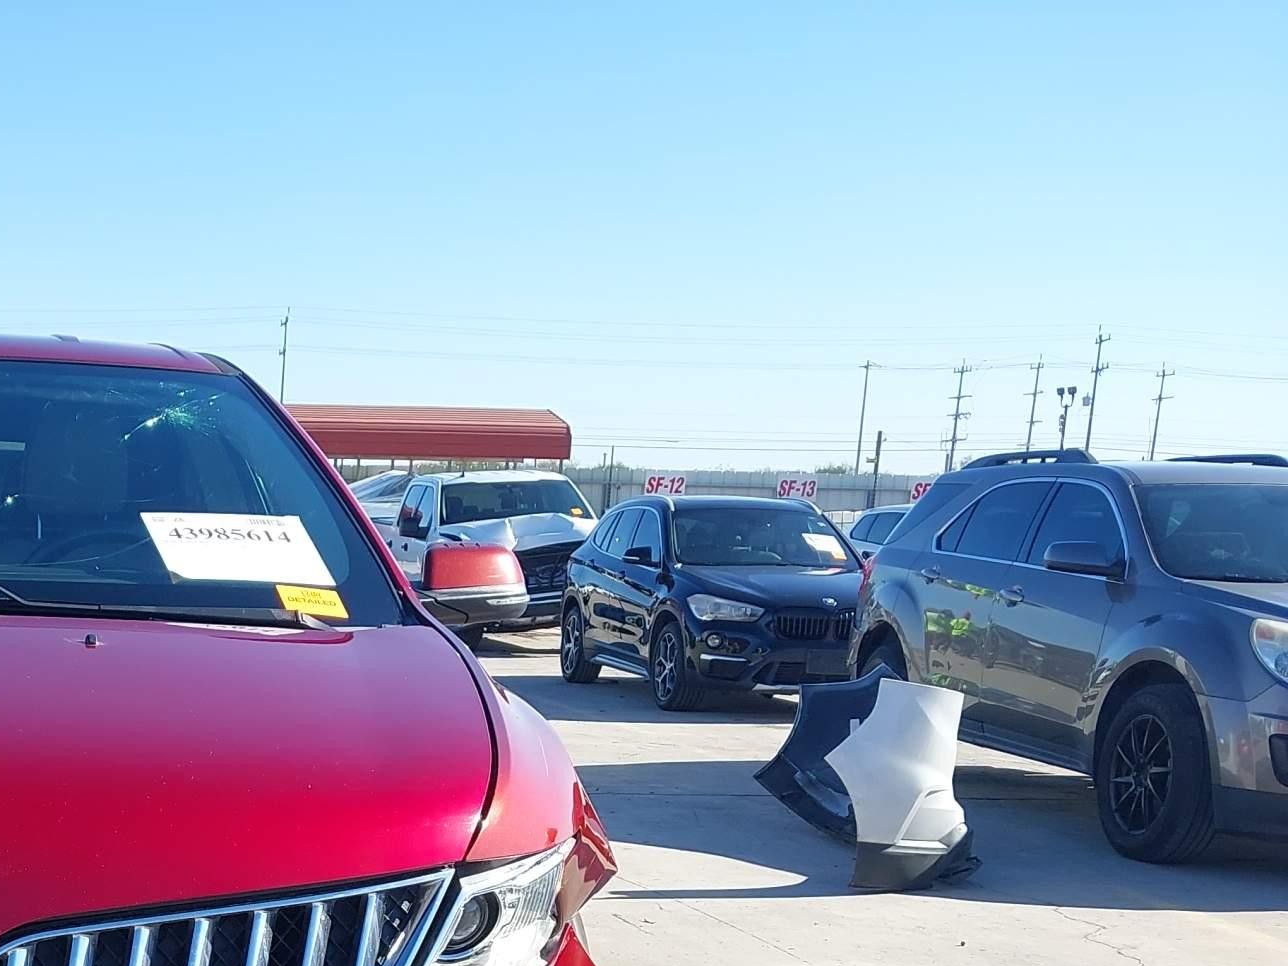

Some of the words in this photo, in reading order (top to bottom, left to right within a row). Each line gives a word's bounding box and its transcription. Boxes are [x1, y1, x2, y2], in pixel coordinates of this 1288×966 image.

[645, 475, 685, 495] SF-12
[777, 479, 817, 498] SF-13
[168, 527, 292, 544] 43985614
